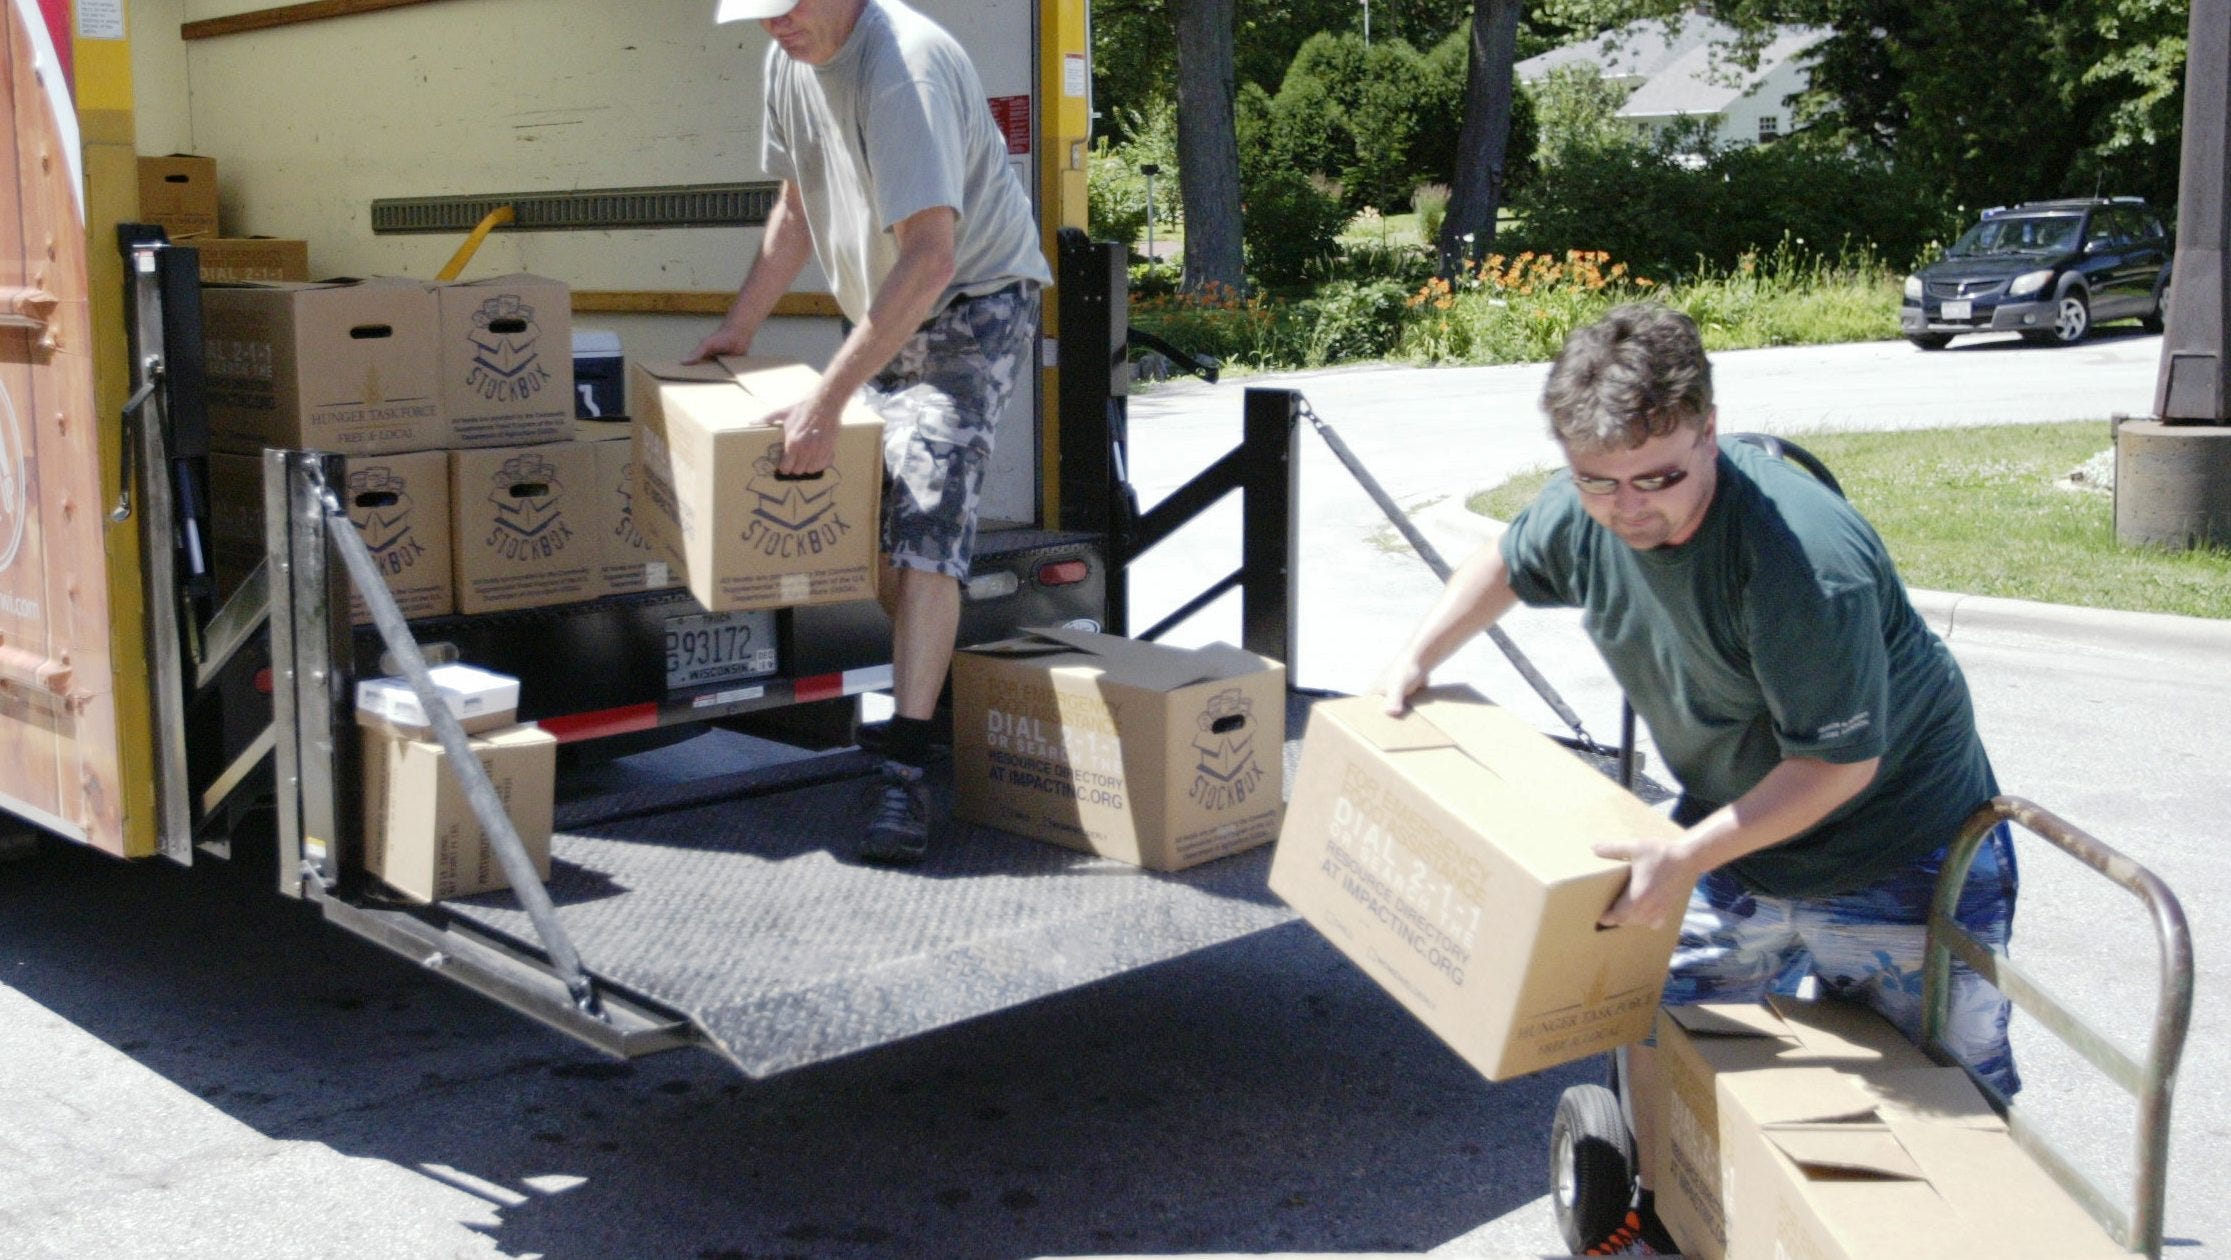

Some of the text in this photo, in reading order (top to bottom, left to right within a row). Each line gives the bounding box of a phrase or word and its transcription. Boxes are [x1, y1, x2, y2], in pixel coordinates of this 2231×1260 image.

[466, 363, 551, 402] STOCKBOX
[311, 409, 365, 425] HUNGER
[486, 521, 573, 561] STOCKBOX
[741, 513, 850, 558] STOCKBOX
[683, 625, 751, 666] 93172
[689, 662, 749, 679] WISCONSIN
[988, 710, 1048, 742] DIAL
[988, 732, 1009, 749] OR
[990, 751, 1123, 790] RESOURCE DIRECTORY
[990, 766, 1123, 810] AT IMPACTINC.ORG
[1189, 760, 1264, 811] STOCKBOX
[1345, 762, 1492, 882] FOR EMERGENCY
[1328, 821, 1353, 847] OR
[1439, 910, 1475, 949] THE
[1334, 797, 1396, 867] DIAL
[1410, 859, 1483, 933] 2-1-1
[1386, 820, 1487, 906] ASSISTANCE
[1321, 858, 1342, 880] AT
[1342, 873, 1466, 987] IMPACTINC.ORG
[1326, 839, 1394, 902] RESOURCE
[1395, 897, 1472, 965] DIRECTORY
